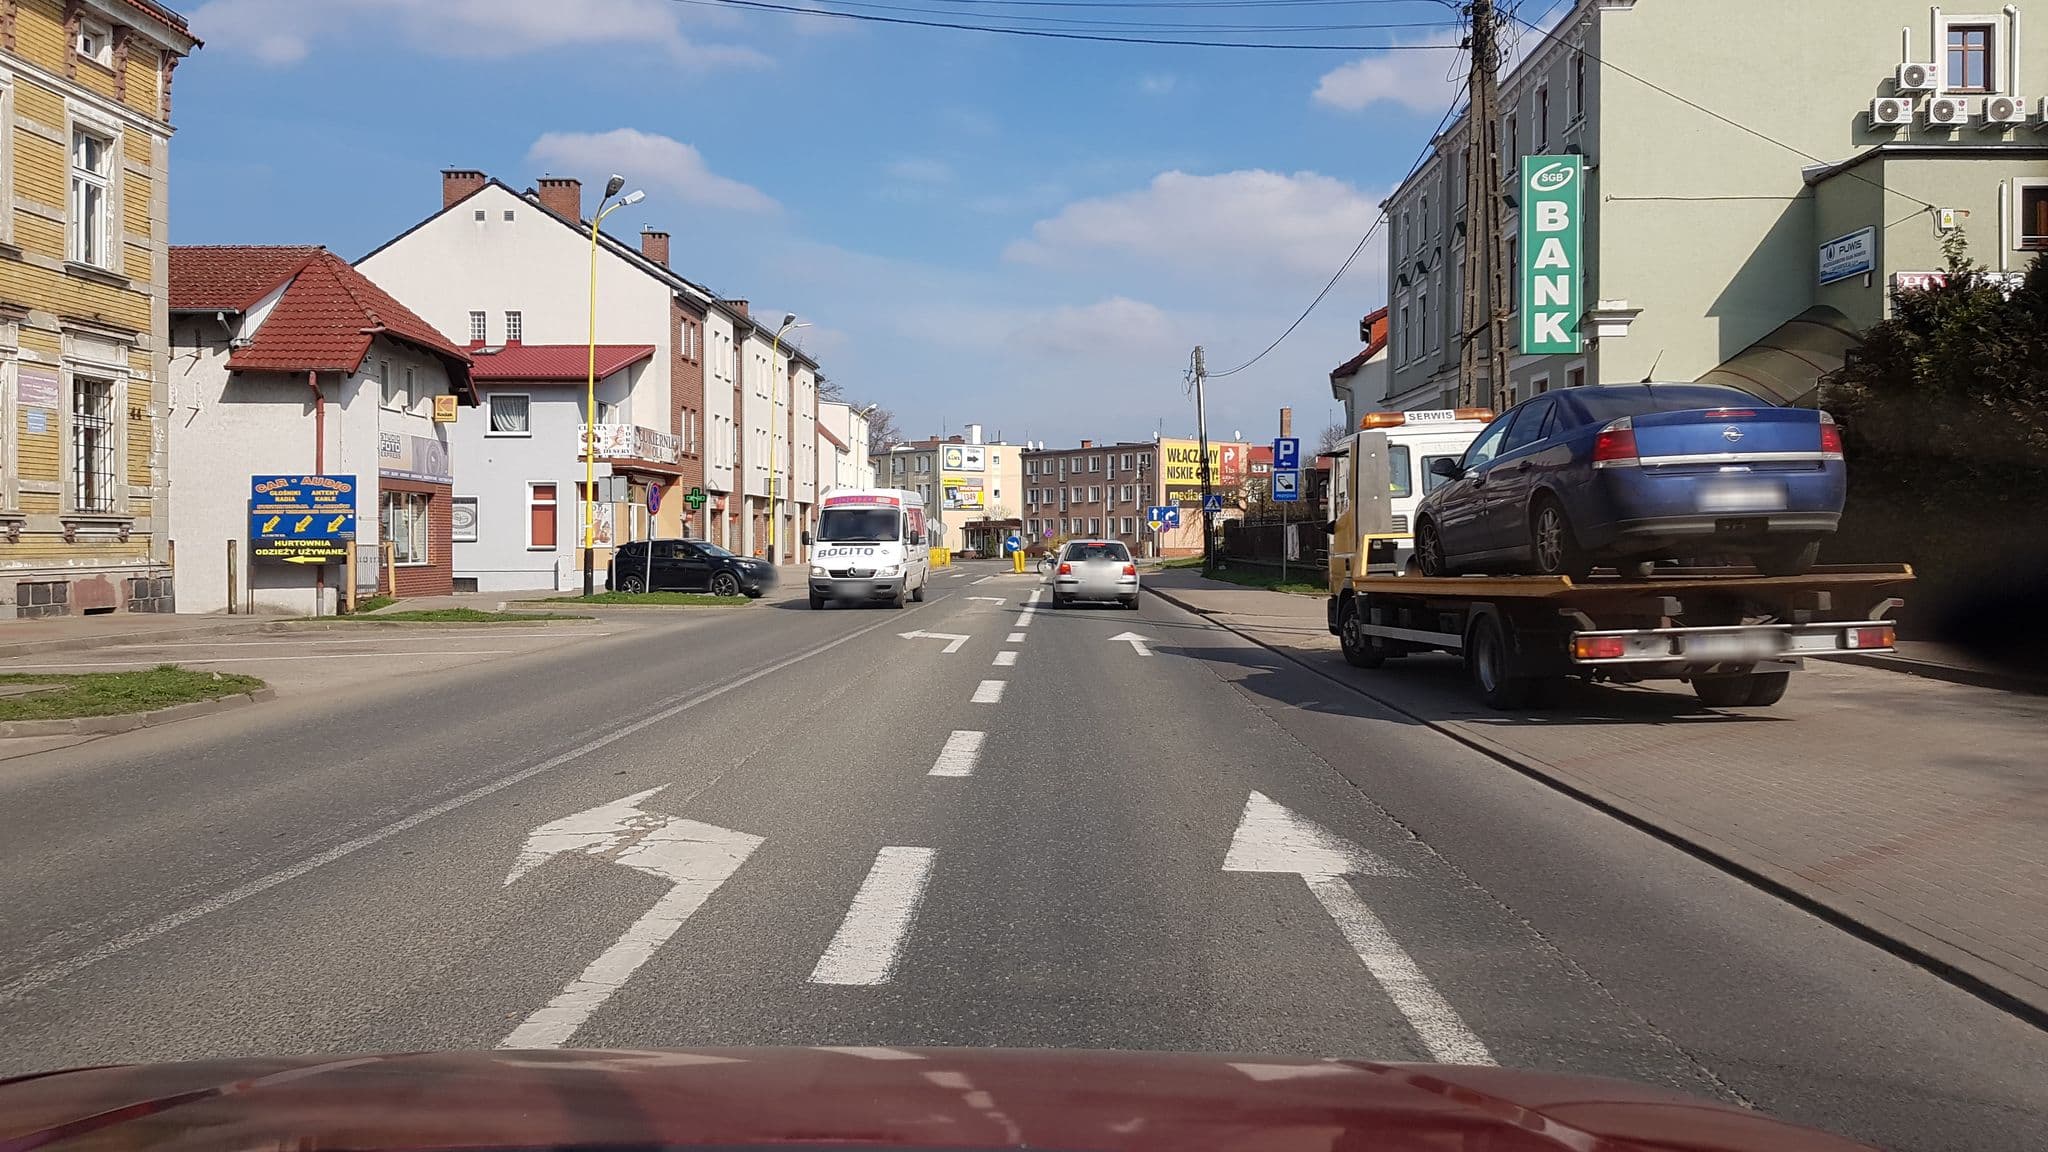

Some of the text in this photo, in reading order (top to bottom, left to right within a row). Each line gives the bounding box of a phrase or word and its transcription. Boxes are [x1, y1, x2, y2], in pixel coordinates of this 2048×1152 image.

[1541, 173, 1564, 182] SGB
[1533, 200, 1572, 344] BANK
[1408, 411, 1453, 421] SERWIS
[381, 440, 401, 453] FOTO
[1279, 440, 1294, 460] P
[1167, 447, 1219, 464] WŁĄCZMY
[1167, 466, 1194, 480] NISKIE
[255, 479, 289, 493] CAR
[300, 476, 352, 493] AUDIO
[255, 548, 295, 556] ODZIEŻY
[817, 547, 875, 558] BOGITO
